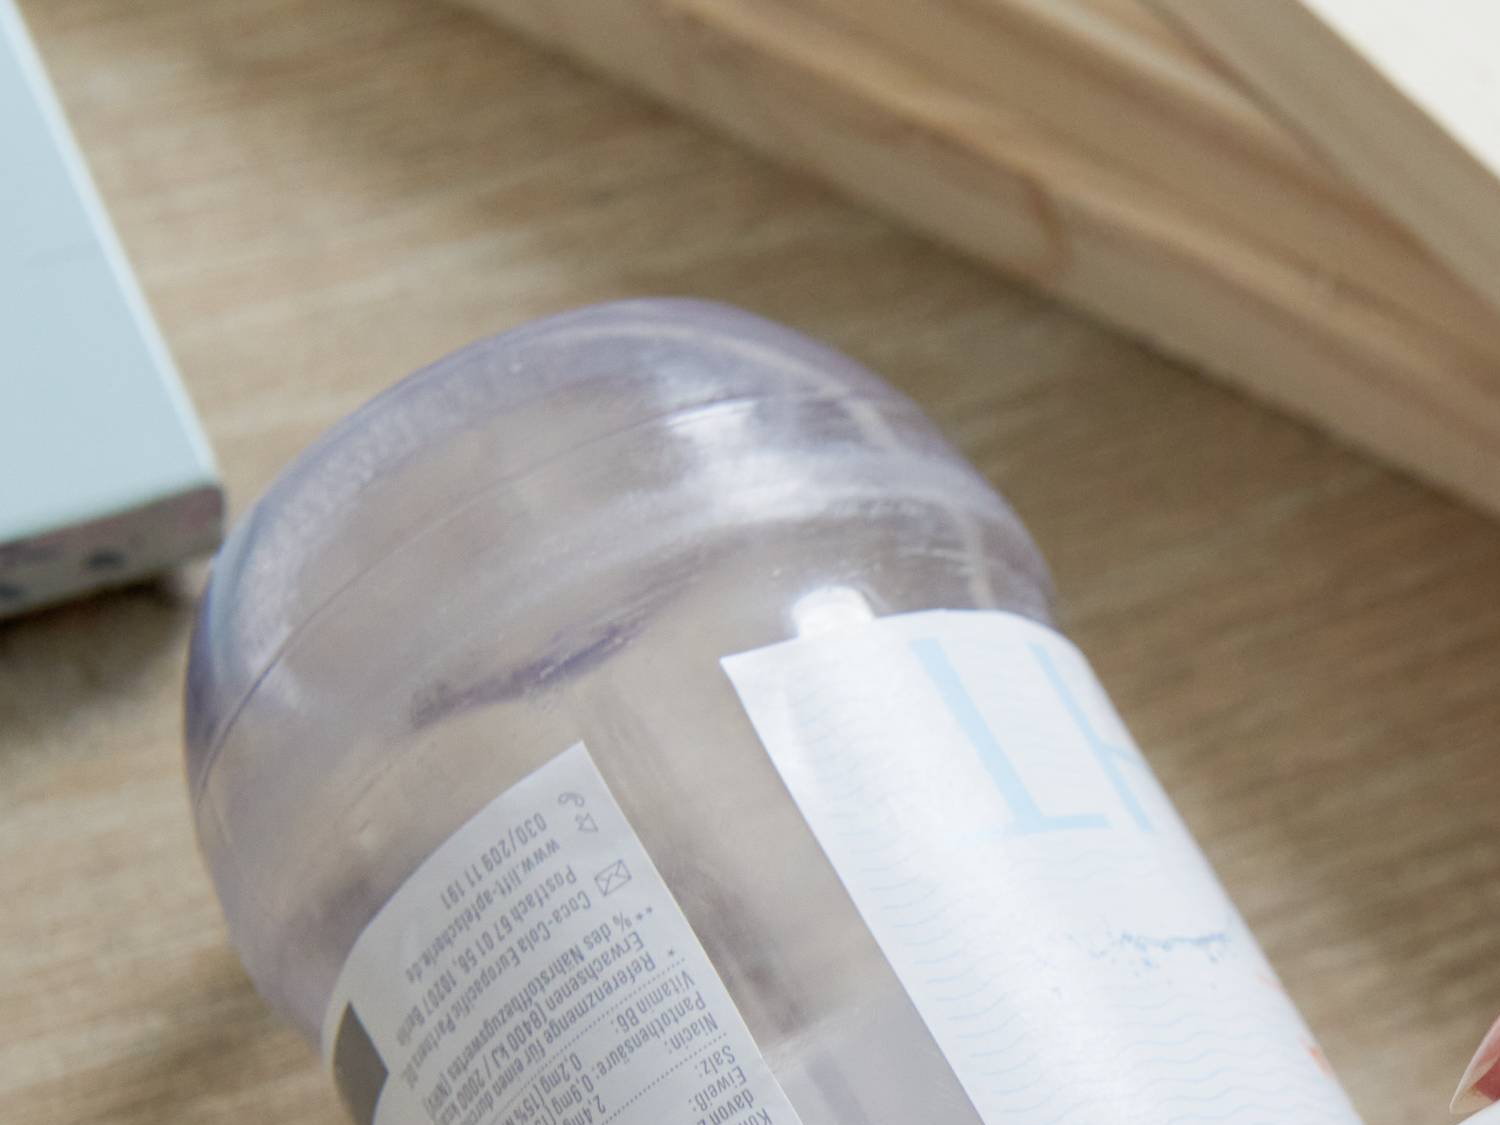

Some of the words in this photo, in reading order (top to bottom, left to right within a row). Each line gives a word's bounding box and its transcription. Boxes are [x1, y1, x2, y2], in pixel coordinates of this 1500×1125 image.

[480, 812, 548, 873] 030/209
[463, 863, 483, 888] 11
[509, 864, 578, 923] Postfach
[474, 930, 495, 957] 01
[516, 889, 592, 954] Coca-Cola
[582, 922, 612, 951] des
[611, 911, 633, 933] %
[450, 945, 521, 1020] Europacific
[544, 931, 645, 1012] Erwachsenen
[635, 969, 696, 1015] Vitamin
[543, 951, 657, 1045] Referenzmenge
[610, 1006, 641, 1033] B6:
[505, 1001, 548, 1052] (8400
[591, 990, 707, 1080] Pantothensäure:
[663, 1011, 719, 1054] Niacin:
[490, 1042, 511, 1070] kJ
[523, 1037, 547, 1066] für
[538, 1051, 583, 1095] 0,2mg
[694, 1044, 736, 1078] Salz:
[491, 1057, 525, 1097] einen
[550, 1073, 595, 1117] 0,9mg
[688, 1065, 748, 1112] Eiweiß:
